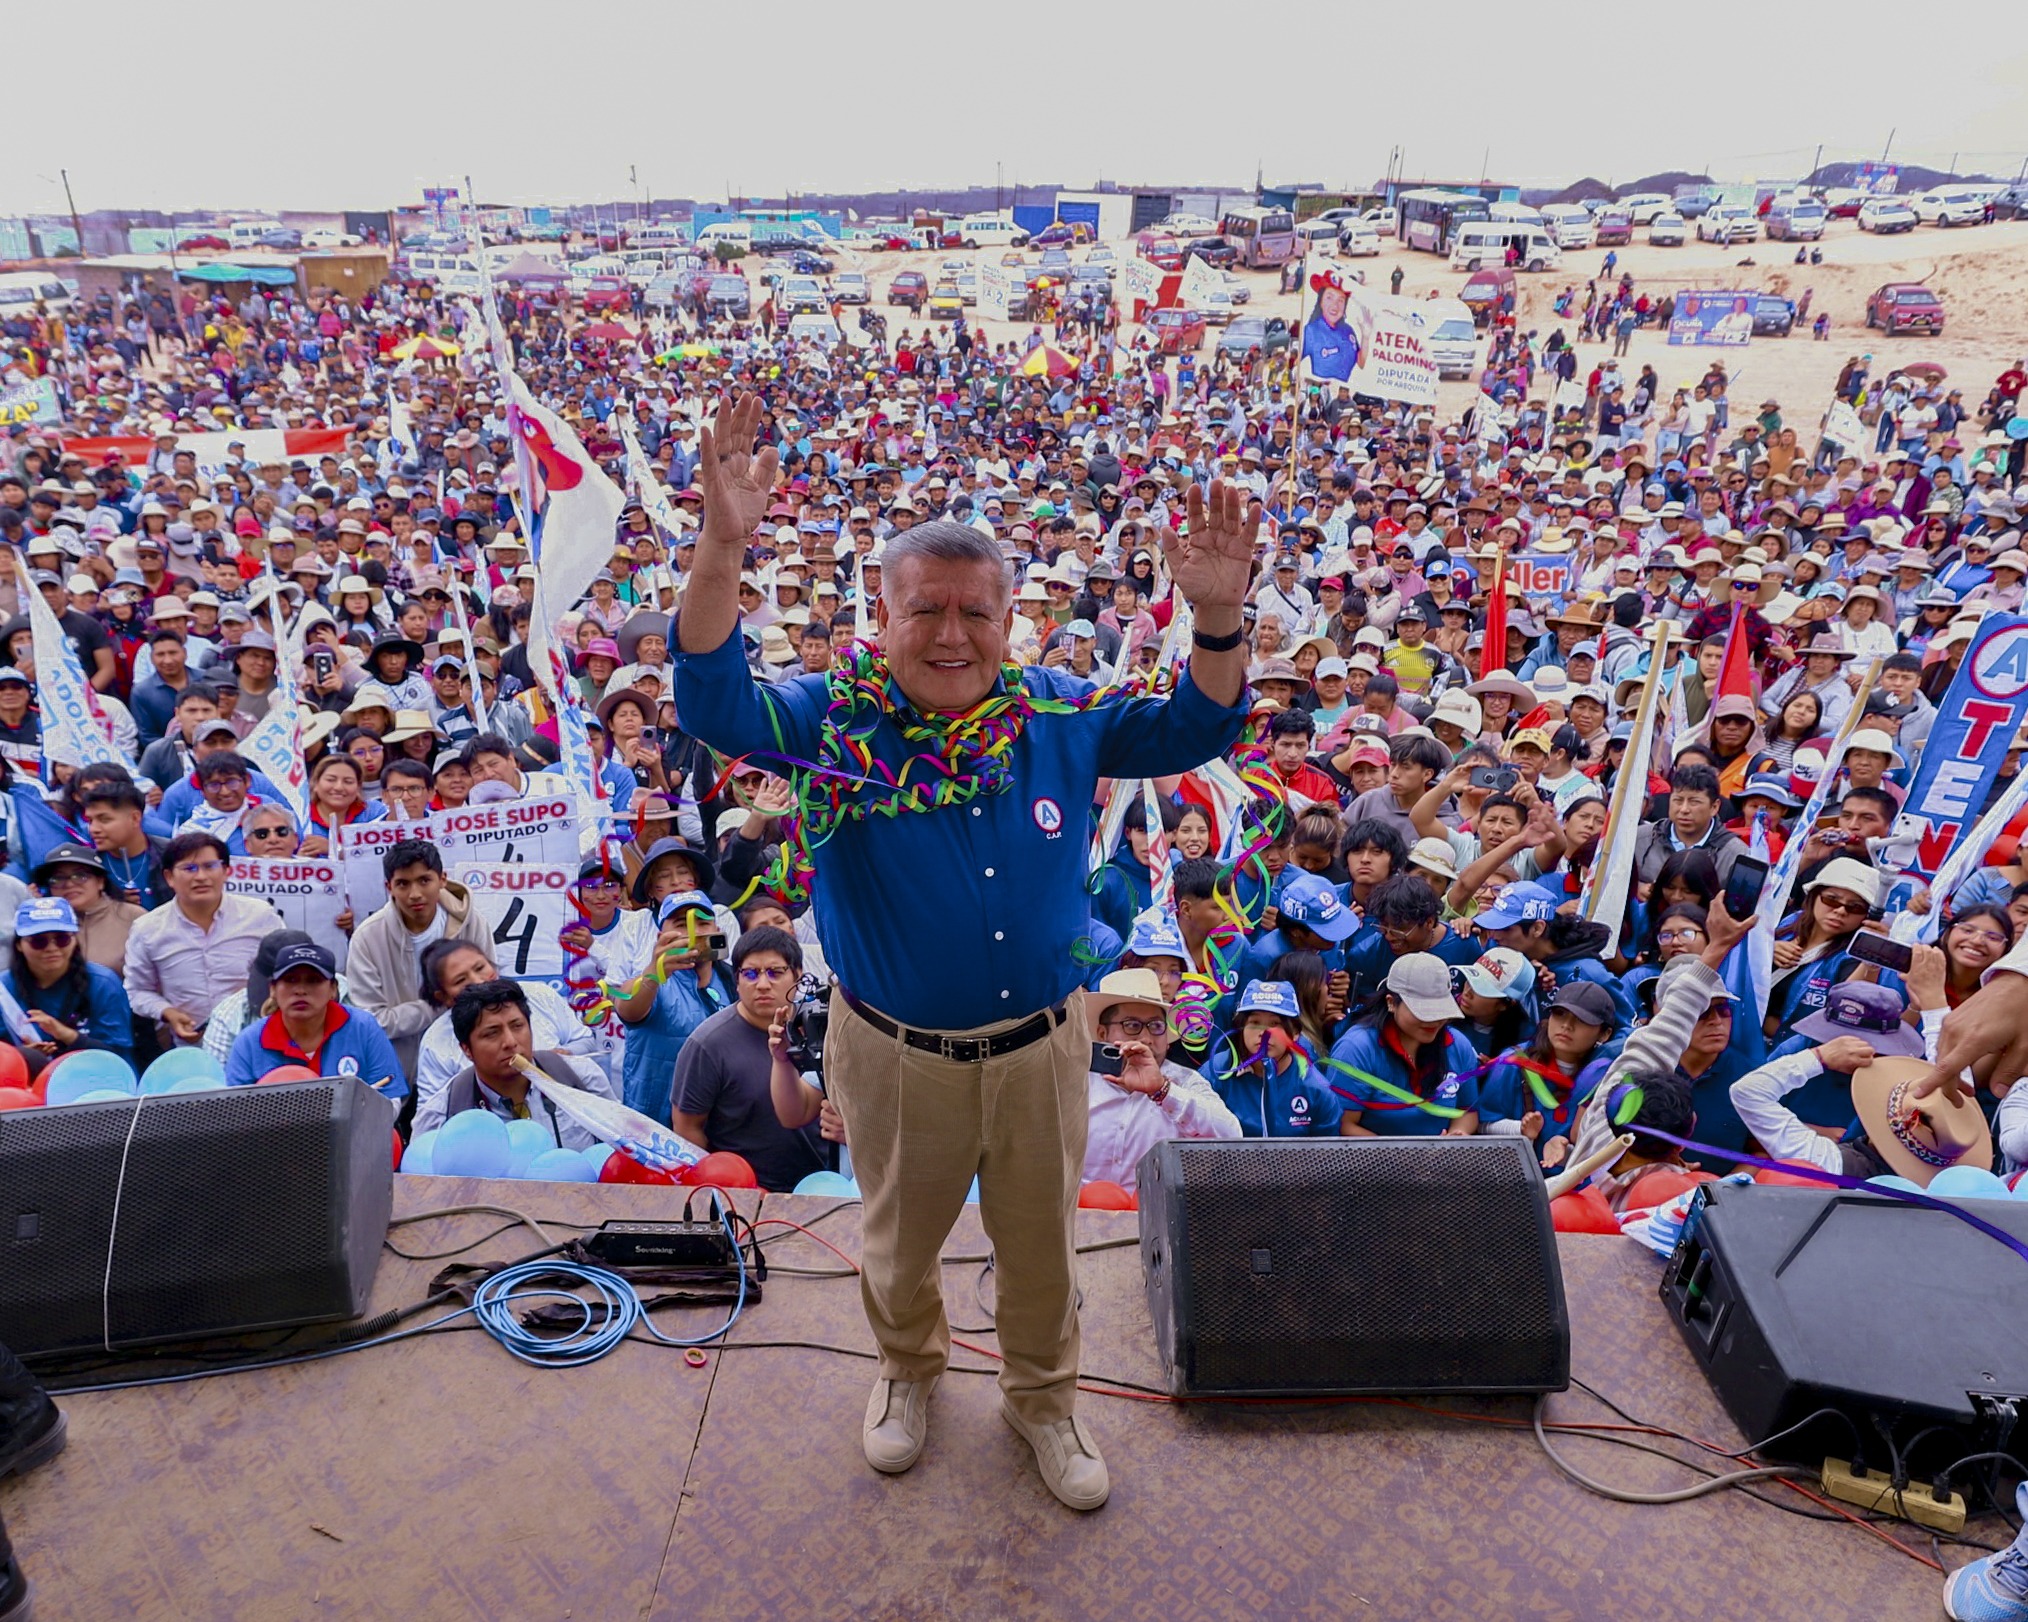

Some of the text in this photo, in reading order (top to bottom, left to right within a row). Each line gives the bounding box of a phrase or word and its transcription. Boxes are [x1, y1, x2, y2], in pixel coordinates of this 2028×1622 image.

[1378, 367, 1430, 385] DIPUTADA
[1511, 560, 1566, 592] ller
[443, 801, 567, 834] JOSÉ SUPO
[1041, 803, 1059, 825] A
[465, 822, 549, 845] DIPUTADO
[225, 860, 334, 882] OSÉ SUPO
[489, 869, 567, 890] SUPO
[225, 882, 313, 895] DIPUTADO
[493, 896, 538, 975] 4
